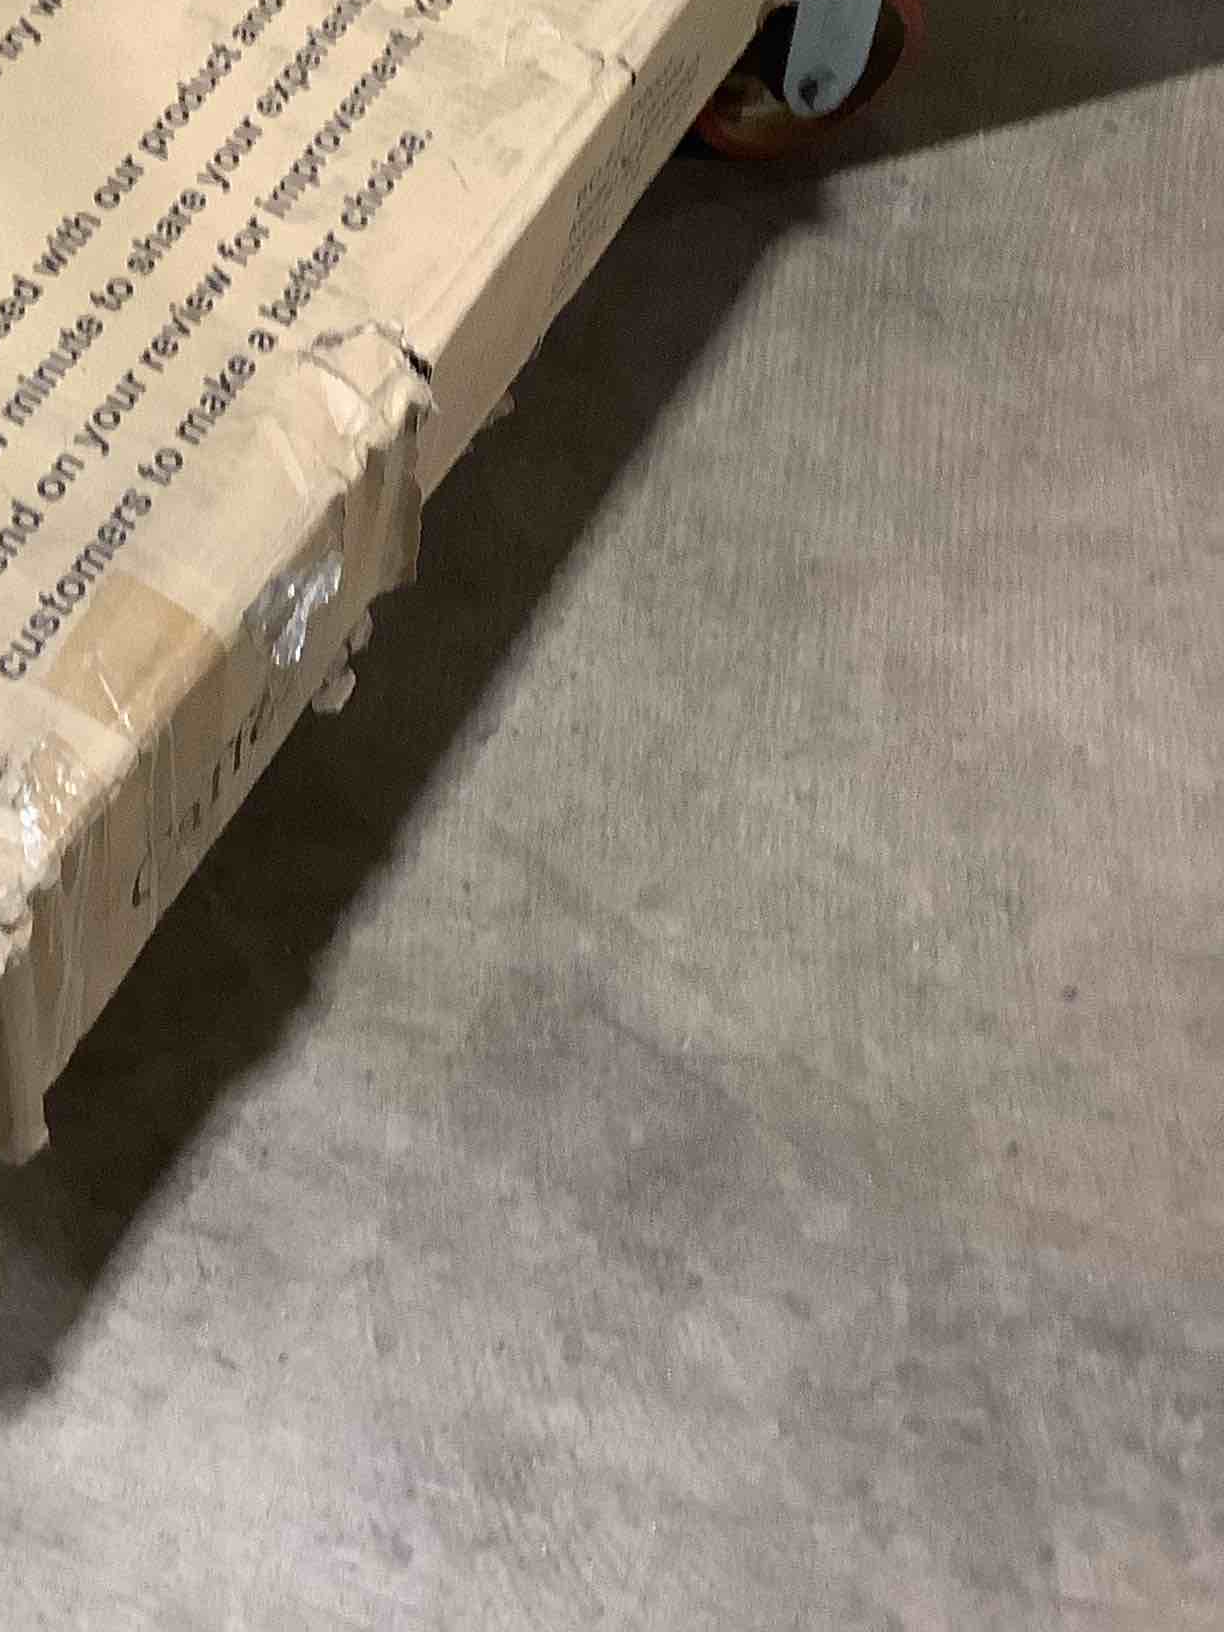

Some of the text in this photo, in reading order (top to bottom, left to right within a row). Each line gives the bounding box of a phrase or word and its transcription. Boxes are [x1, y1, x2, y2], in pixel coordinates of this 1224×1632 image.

[32, 211, 102, 277] with
[93, 153, 145, 210] our
[138, 42, 242, 161] product
[1, 314, 104, 428] minute
[89, 277, 134, 313] to
[126, 189, 207, 277] share
[197, 115, 263, 194] your
[258, 230, 347, 328] better
[36, 453, 85, 503] on
[73, 368, 147, 458] your
[139, 264, 232, 374] review
[216, 215, 270, 268] for
[247, 328, 279, 353] a
[175, 354, 257, 447] make
[137, 448, 184, 488] to
